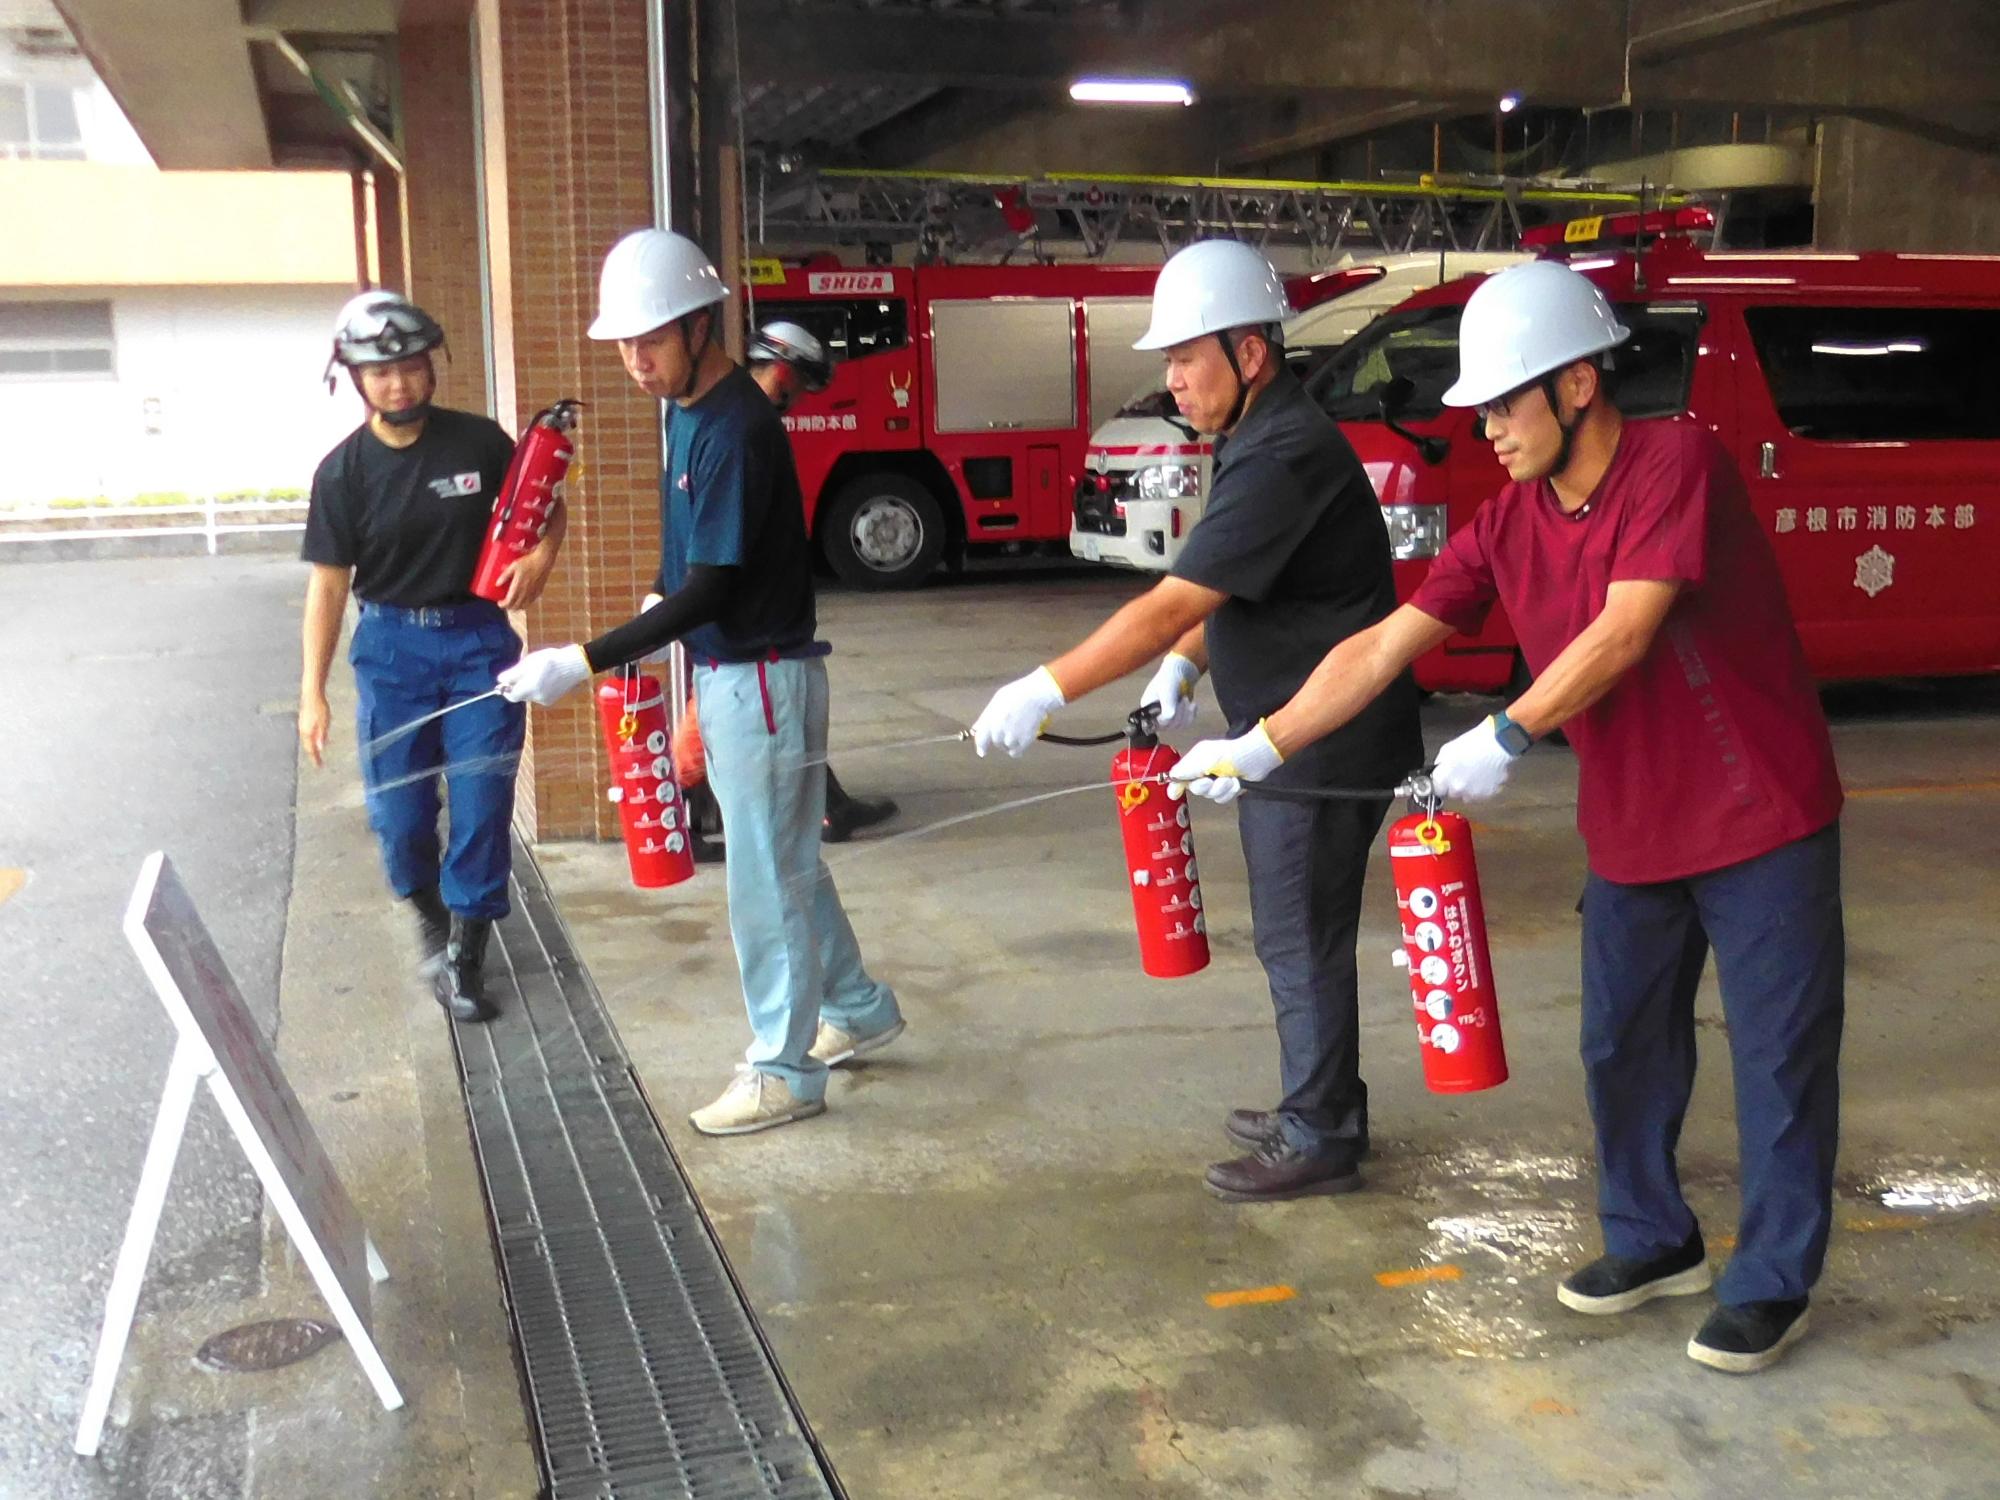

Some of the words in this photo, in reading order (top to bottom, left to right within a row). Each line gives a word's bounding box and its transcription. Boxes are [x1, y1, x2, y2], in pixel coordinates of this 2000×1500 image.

[818, 276, 883, 290] SHIGA
[1775, 504, 1975, 533] 彦根市消防本部
